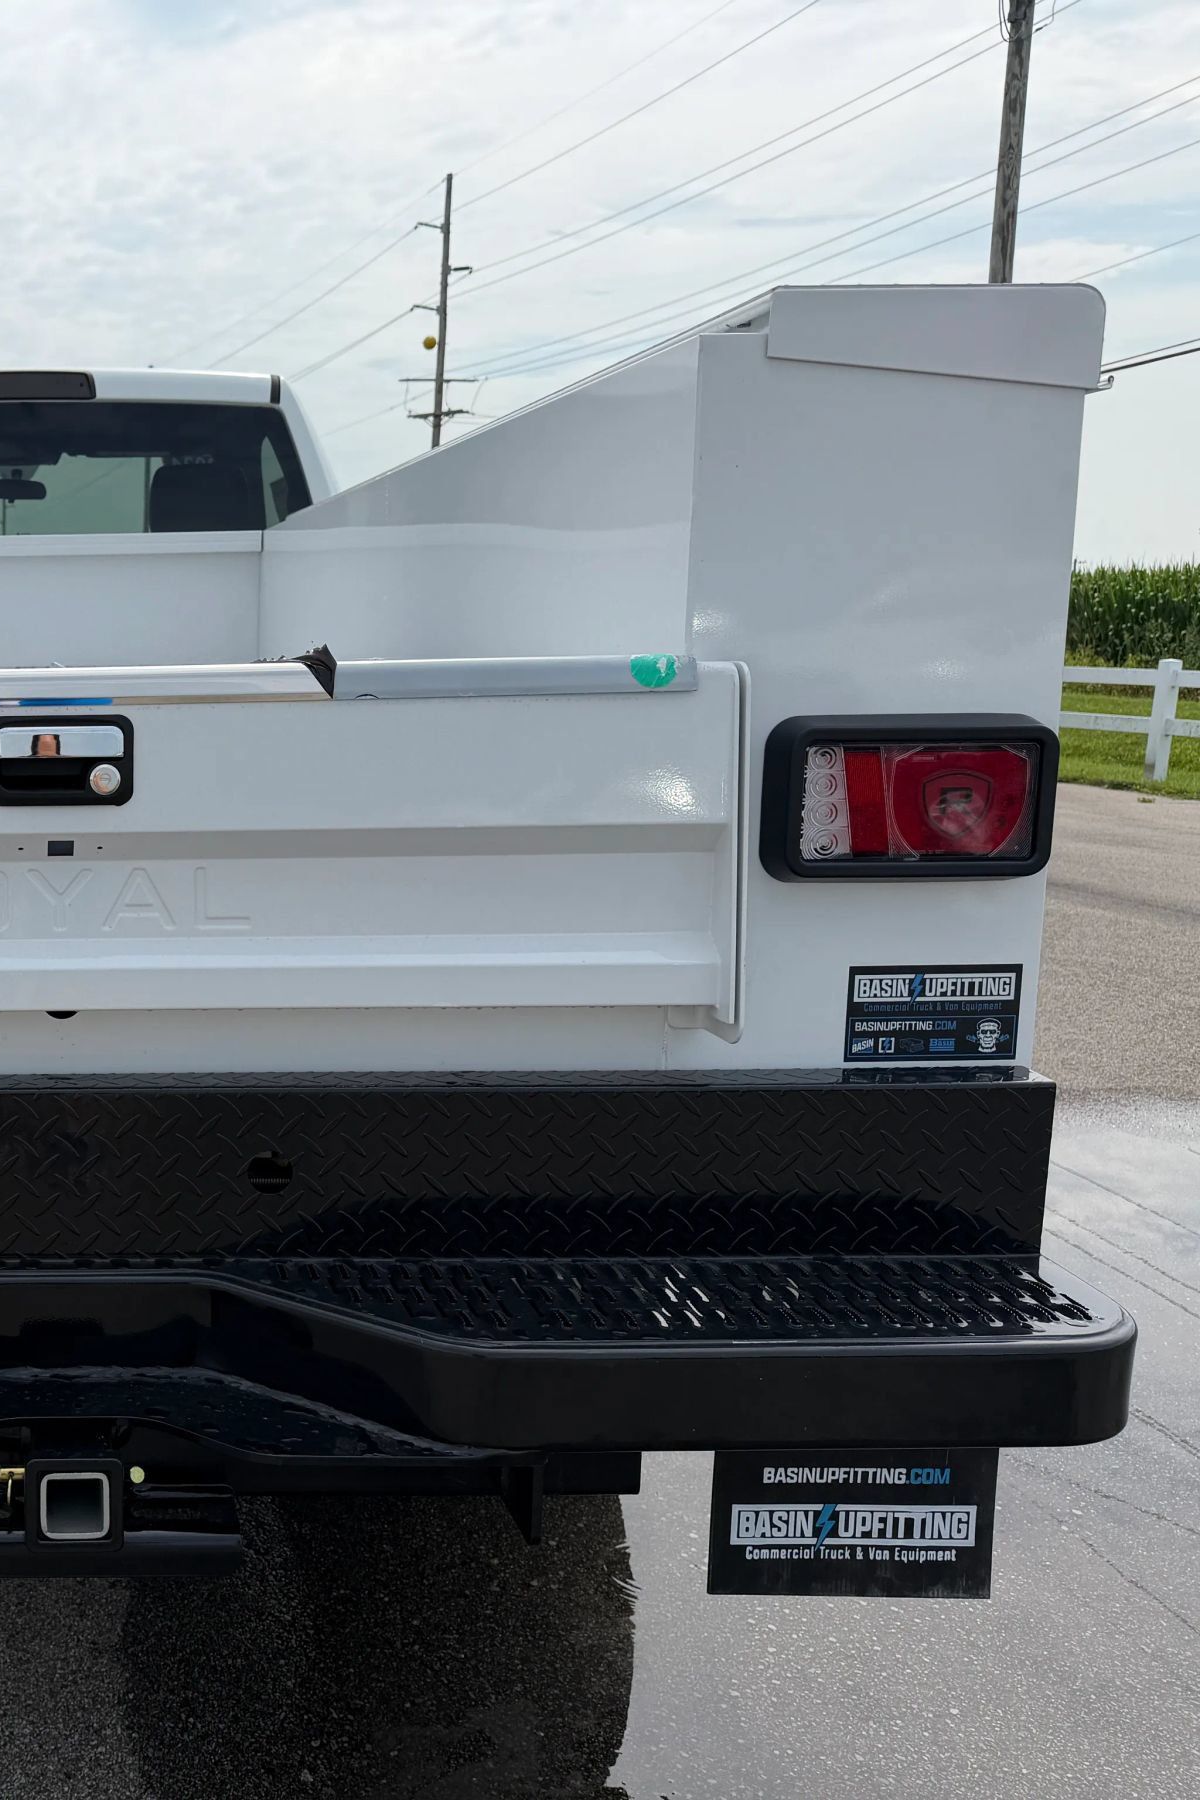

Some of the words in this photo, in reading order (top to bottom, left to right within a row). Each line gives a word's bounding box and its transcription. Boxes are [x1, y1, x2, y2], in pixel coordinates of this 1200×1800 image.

[859, 978, 909, 998] BASIN
[925, 977, 1010, 997] UPFITTING
[863, 1003, 910, 1013] Commercial
[913, 1002, 933, 1012] Truck
[936, 1003, 942, 1011] &
[944, 1002, 959, 1011] Van
[961, 1002, 1003, 1013] Equipment
[855, 1020, 956, 1032] BASINUPFITTING.COM
[851, 1038, 874, 1053] BASIN
[763, 1467, 951, 1485] BASINUPFITTING.COM
[738, 1511, 814, 1538] BASIN
[838, 1512, 969, 1539] UPFITTING
[745, 1547, 814, 1560] Commercial
[819, 1547, 851, 1560] Truck
[856, 1547, 863, 1560] &
[869, 1548, 890, 1561] Van
[894, 1548, 957, 1563] Equipment
